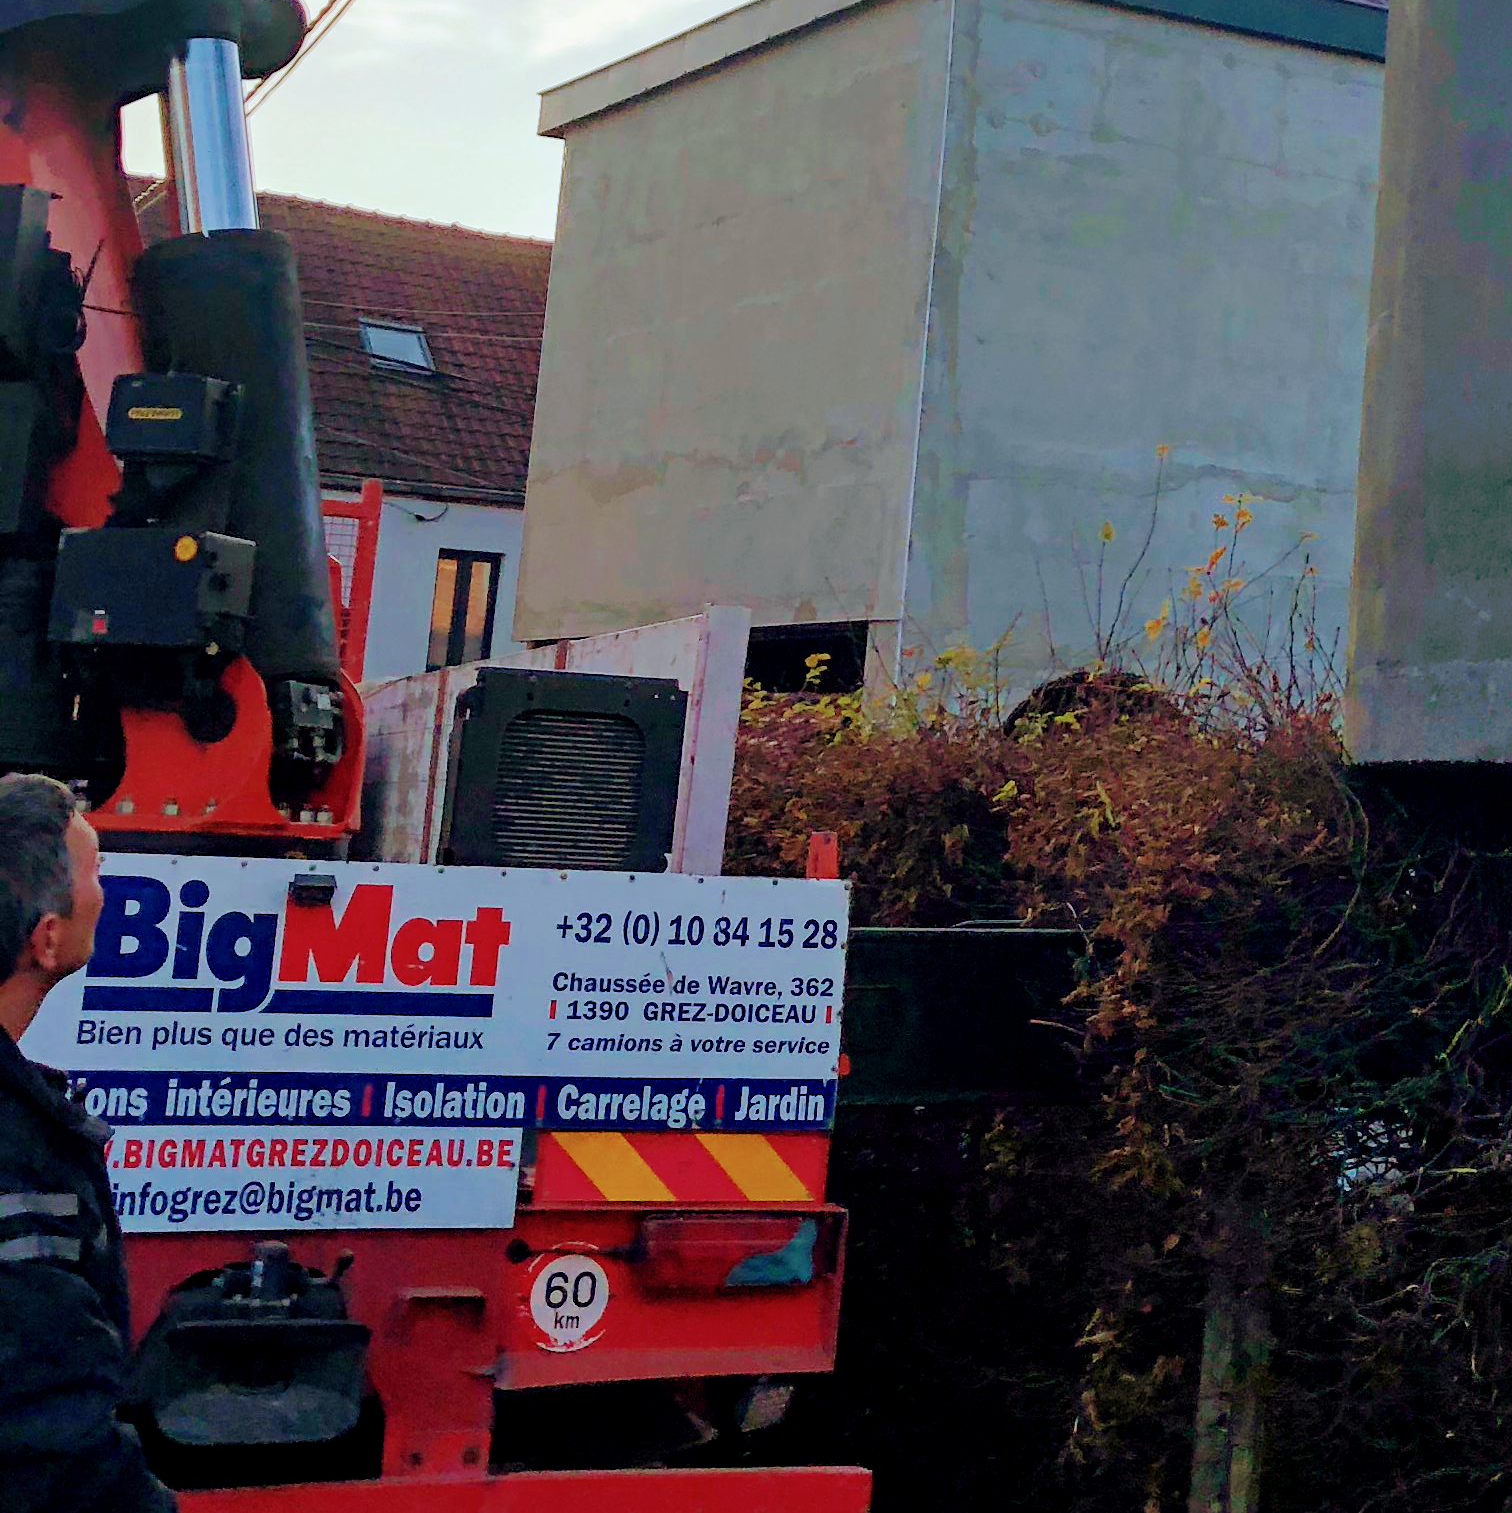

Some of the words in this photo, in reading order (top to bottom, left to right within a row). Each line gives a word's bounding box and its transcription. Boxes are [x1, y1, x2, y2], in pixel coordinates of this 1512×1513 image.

[85, 874, 511, 1013] BigMat
[556, 912, 612, 943] +32
[623, 910, 660, 946] (0)
[668, 915, 705, 946] 10
[758, 917, 794, 948] 15
[802, 919, 838, 949] 28
[552, 972, 665, 994] Chaussée
[673, 975, 700, 995] de
[707, 975, 783, 1000] Wavre,
[790, 977, 834, 997] 362
[566, 1001, 629, 1020] 1390
[643, 1002, 817, 1024] GREZ-DOICEAU
[76, 1019, 142, 1046] Bien
[151, 1020, 212, 1050] plus
[220, 1027, 276, 1051] que
[283, 1024, 334, 1048] des
[342, 1024, 485, 1050] matériaux
[547, 1032, 561, 1051] 7
[567, 1034, 663, 1052] camions
[669, 1034, 682, 1053] à
[690, 1036, 746, 1054] votre
[752, 1037, 830, 1055] service
[65, 1077, 149, 1118] ons
[164, 1076, 352, 1118] intérieures
[382, 1081, 526, 1120] Isolation
[556, 1084, 707, 1129] Carrelage
[734, 1086, 826, 1121] Jardin
[111, 1181, 423, 1224] infogrez@bigmat.be
[545, 1271, 597, 1309] 60
[554, 1311, 580, 1329] km
